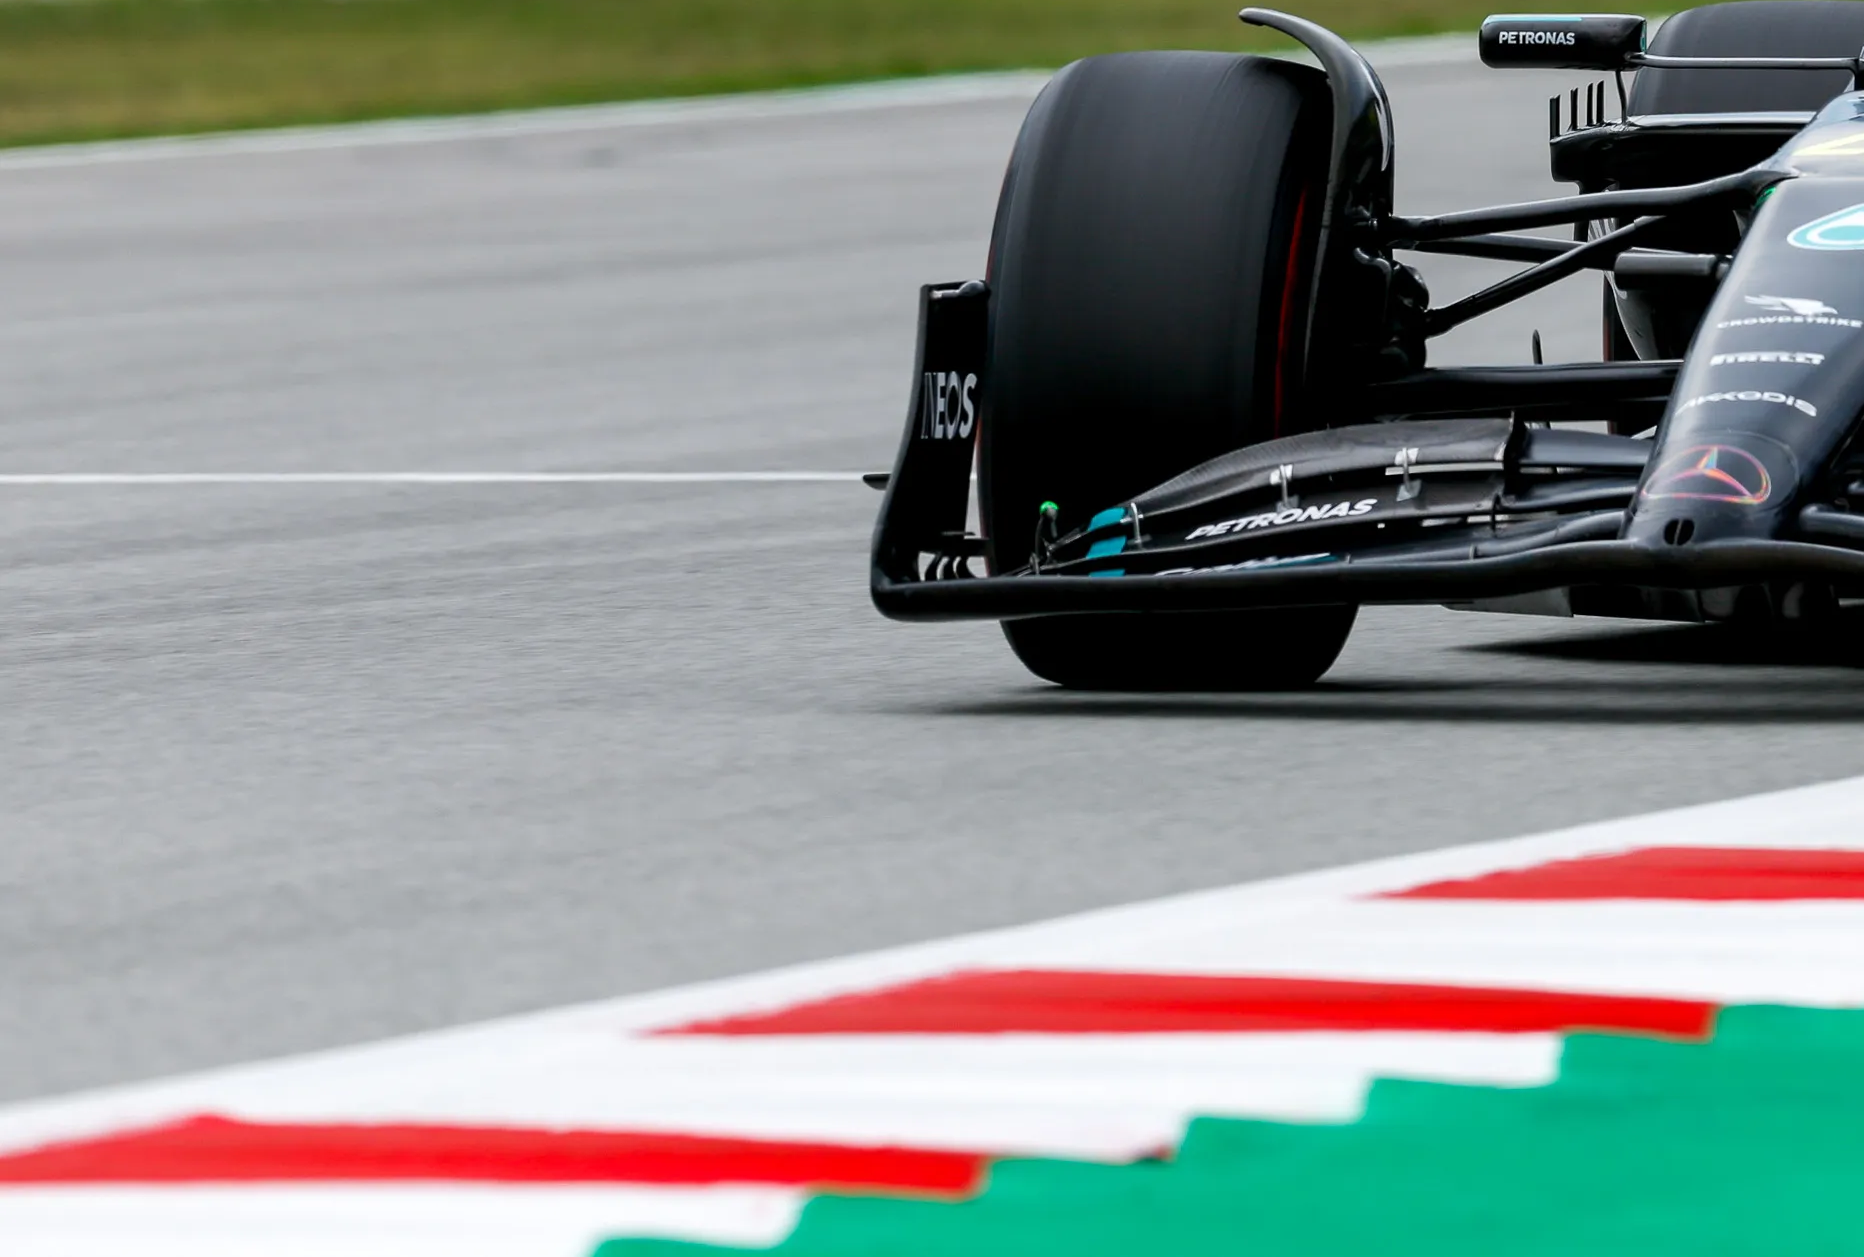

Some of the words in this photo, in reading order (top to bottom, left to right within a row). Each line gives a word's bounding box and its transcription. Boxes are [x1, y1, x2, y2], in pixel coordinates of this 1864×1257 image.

[1499, 31, 1575, 45] PETRONAS
[1716, 315, 1864, 329] CROWDSTRIKE
[1185, 498, 1378, 541] PETRONAS
